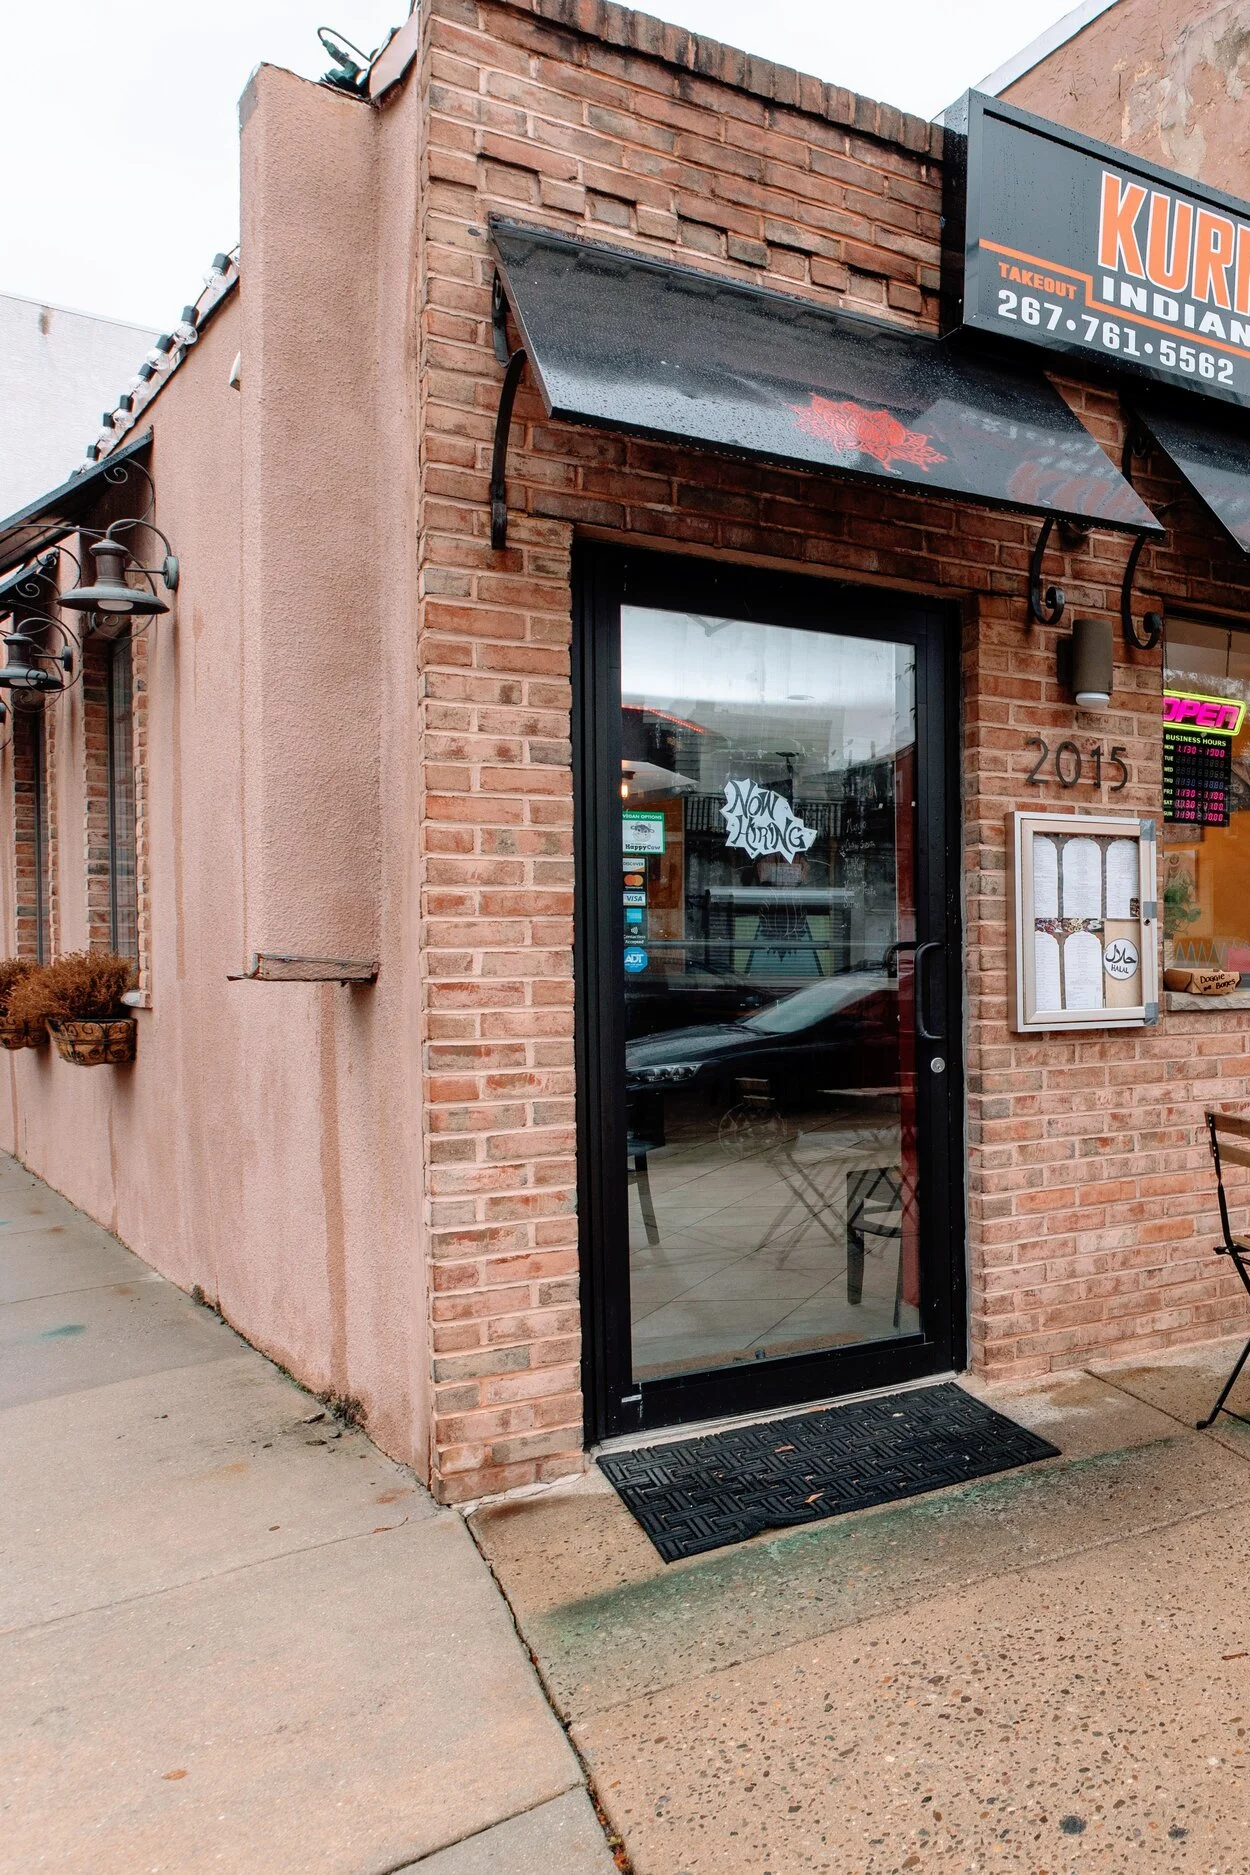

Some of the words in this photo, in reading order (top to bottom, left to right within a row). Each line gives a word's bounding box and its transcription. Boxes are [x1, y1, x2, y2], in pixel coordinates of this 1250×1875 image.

[998, 261, 1077, 300] TAKEOUT
[1162, 696, 1240, 730] OPEN
[1165, 733, 1201, 744] BUSINESS
[1202, 738, 1227, 747] HOURS
[1026, 737, 1128, 791] 2015
[726, 779, 780, 820] NOW
[730, 815, 806, 854] HIRING
[624, 954, 644, 963] ADT
[1105, 944, 1136, 964] حلال
[1111, 964, 1129, 974] HALAL
